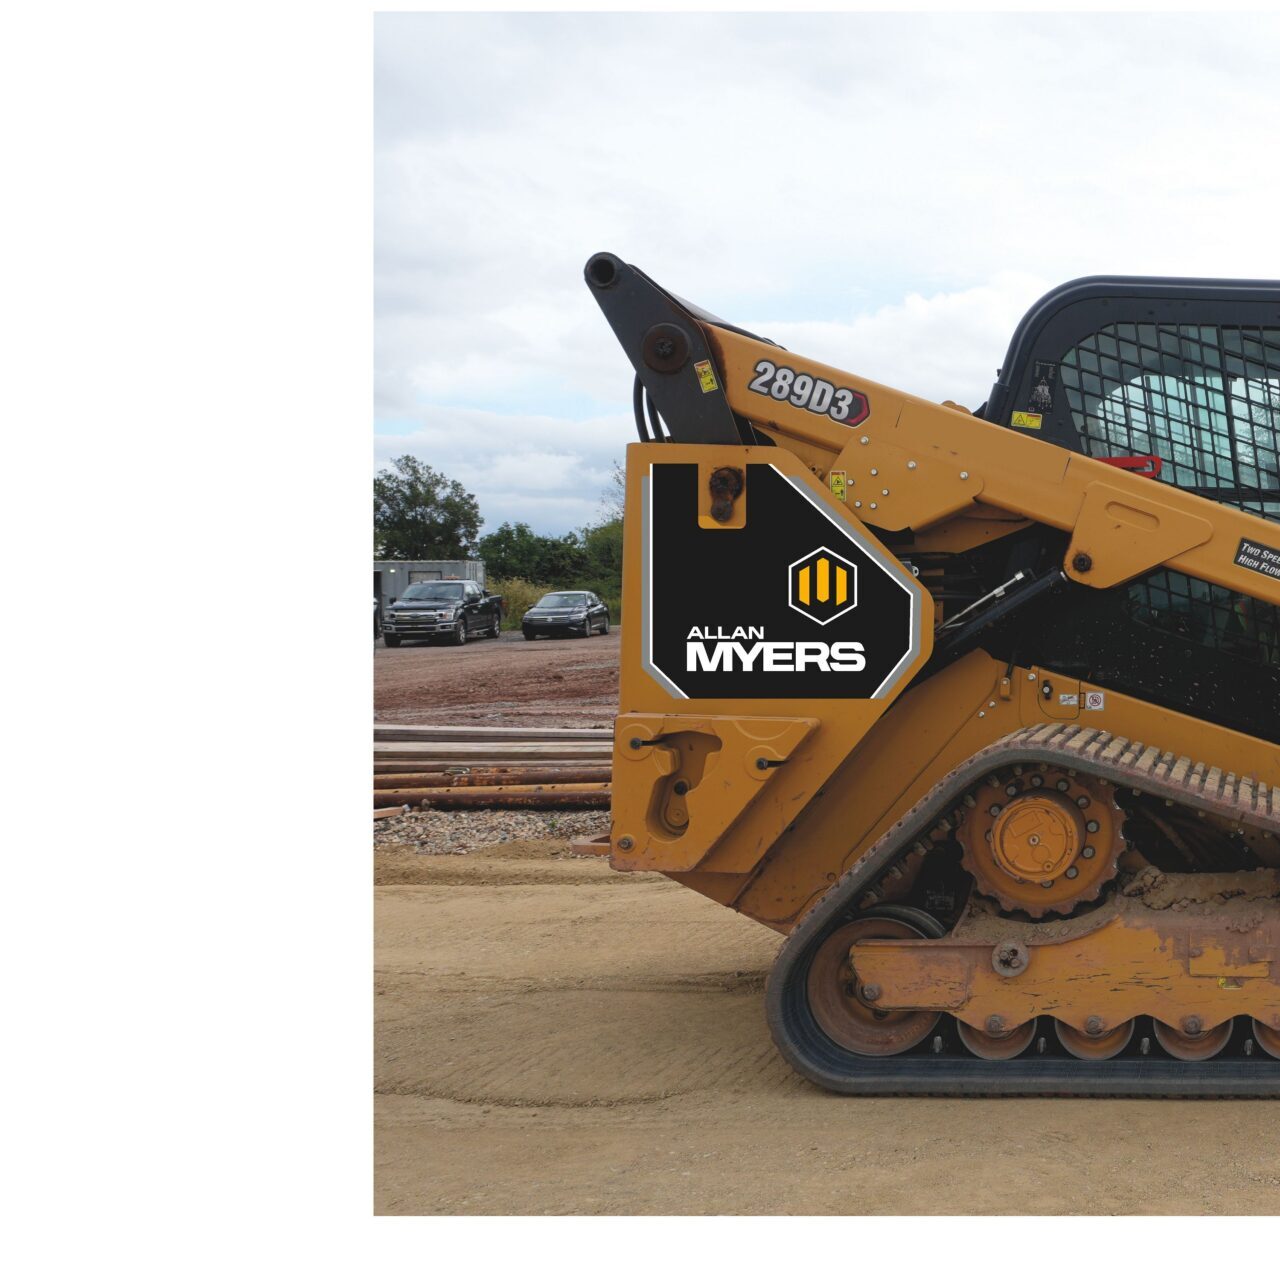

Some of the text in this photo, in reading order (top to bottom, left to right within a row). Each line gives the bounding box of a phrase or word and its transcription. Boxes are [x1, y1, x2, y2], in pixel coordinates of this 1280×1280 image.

[749, 360, 854, 420] 289D3
[687, 626, 764, 640] ALLAN
[687, 641, 866, 672] MYERS
